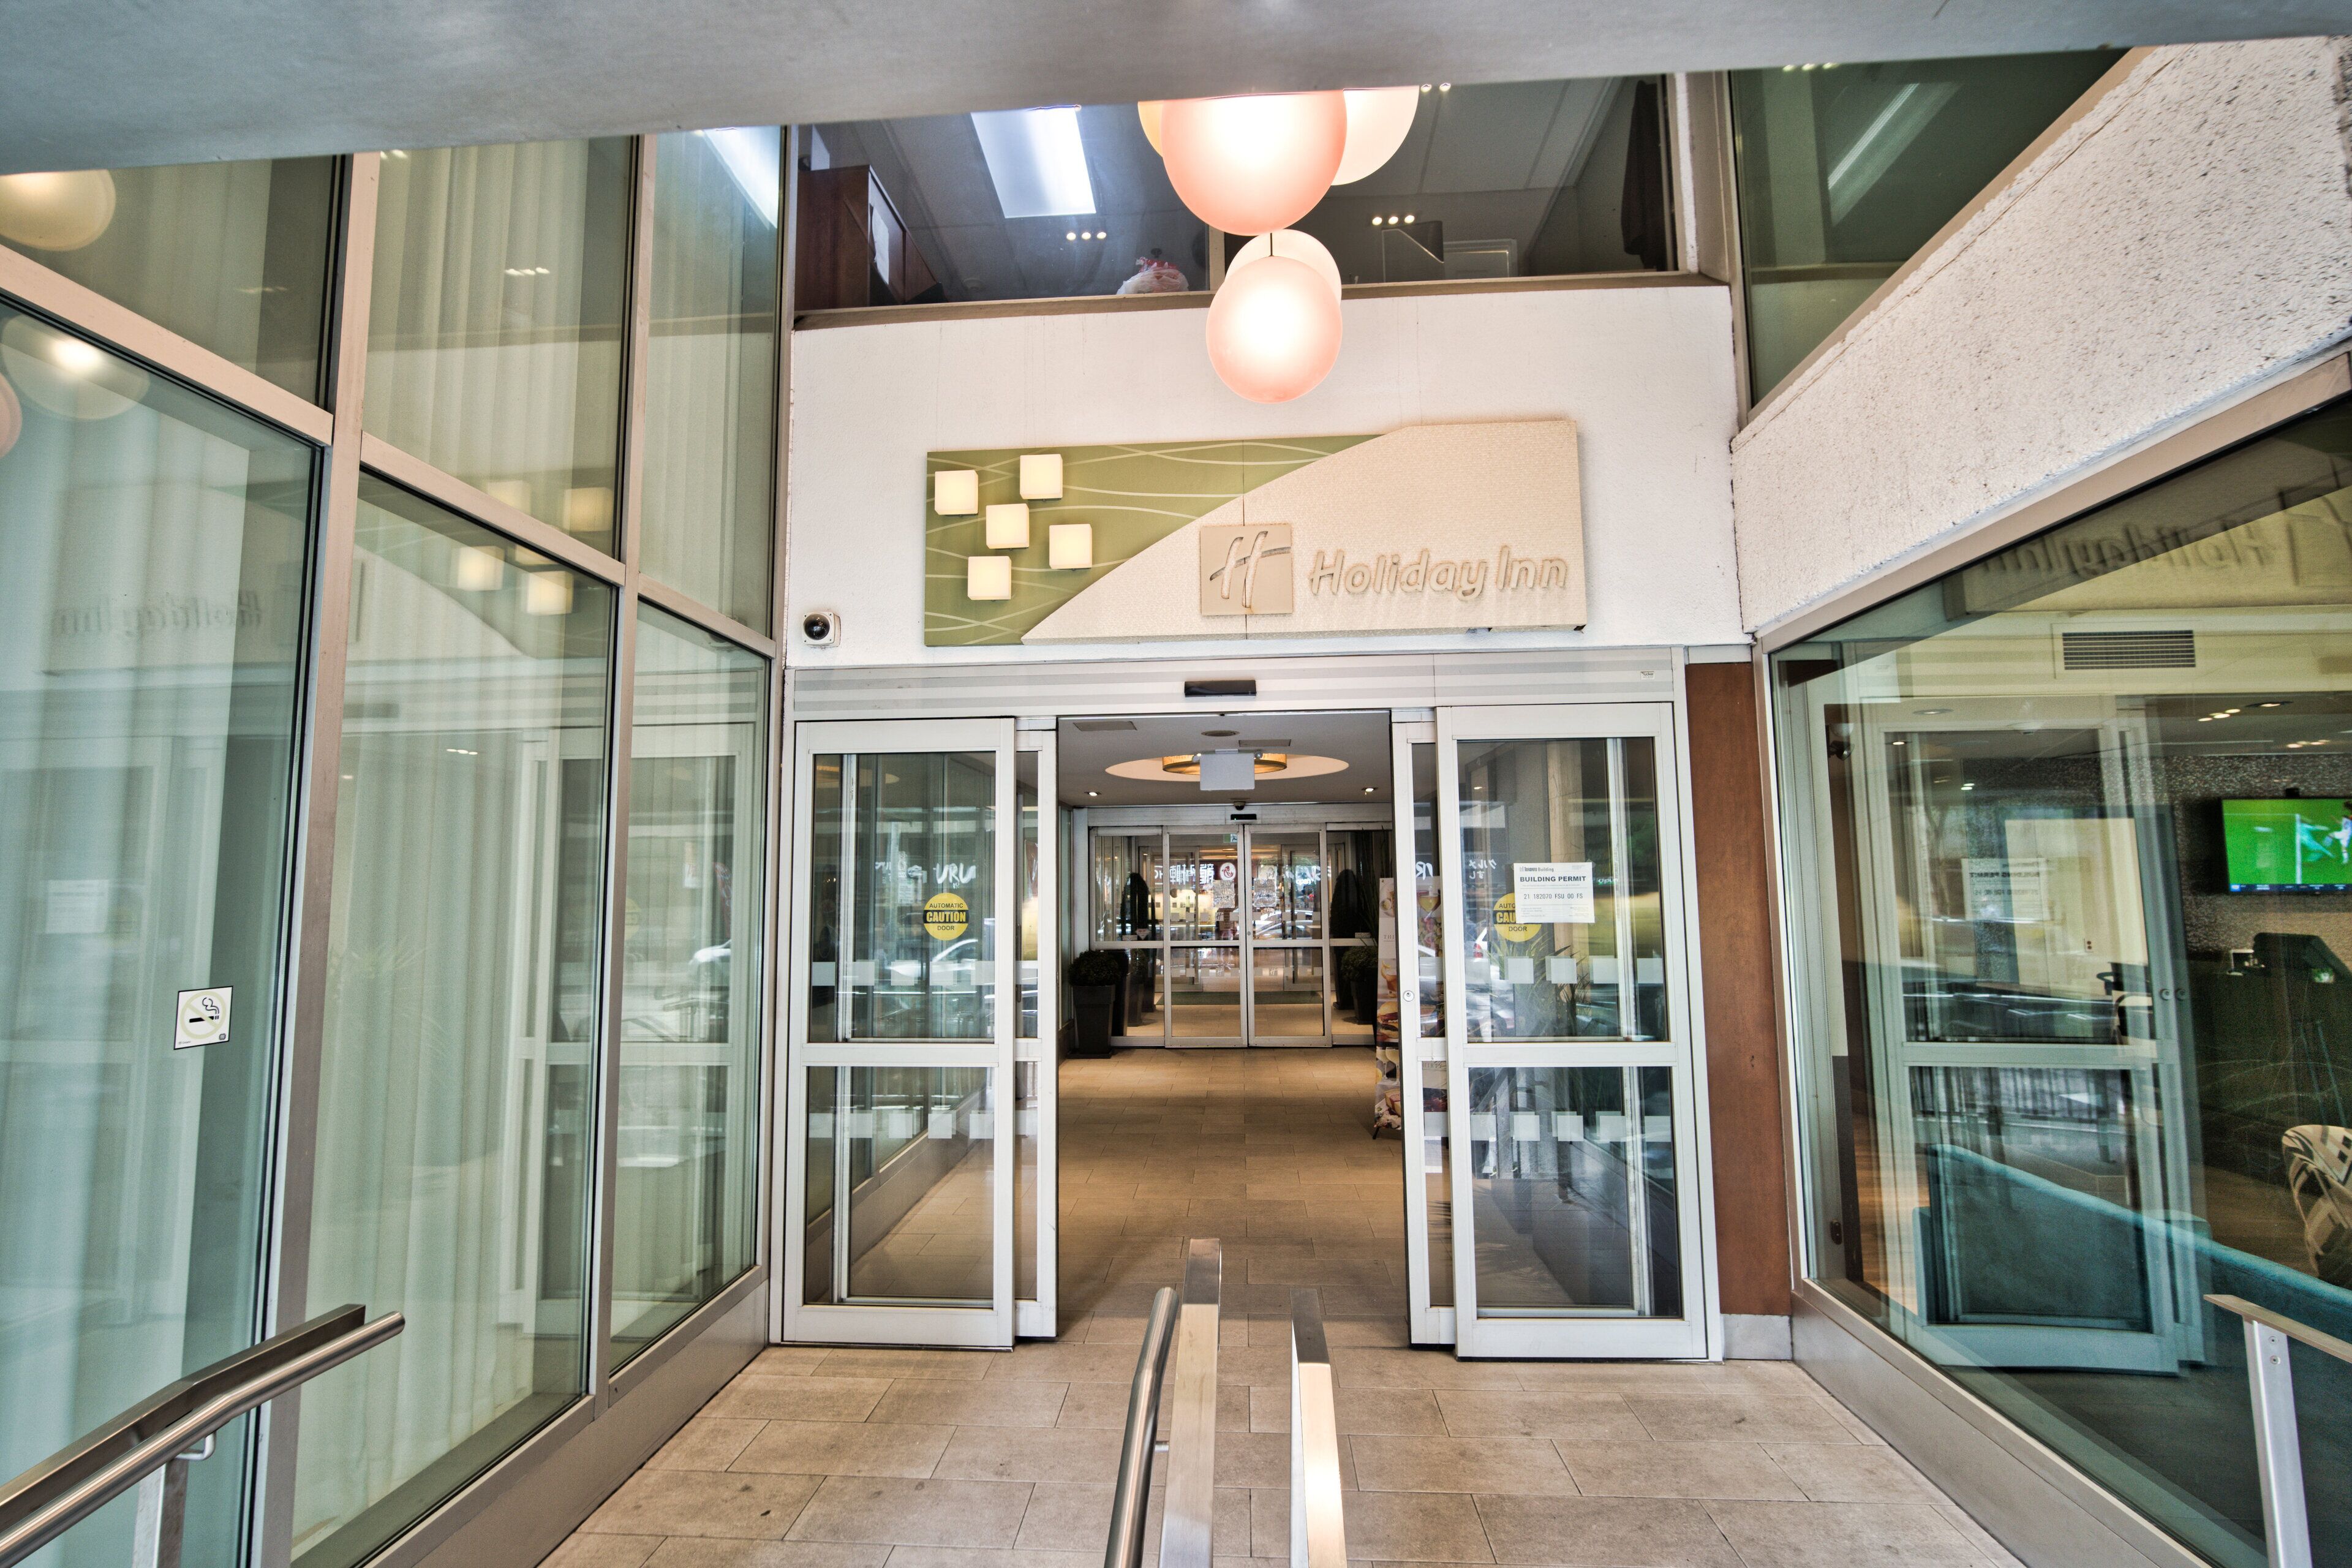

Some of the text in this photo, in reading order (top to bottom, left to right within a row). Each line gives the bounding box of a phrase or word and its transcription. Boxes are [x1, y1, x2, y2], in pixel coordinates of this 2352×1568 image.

[1310, 545, 1568, 603] Holiday Inn
[926, 911, 966, 922] CAUTION
